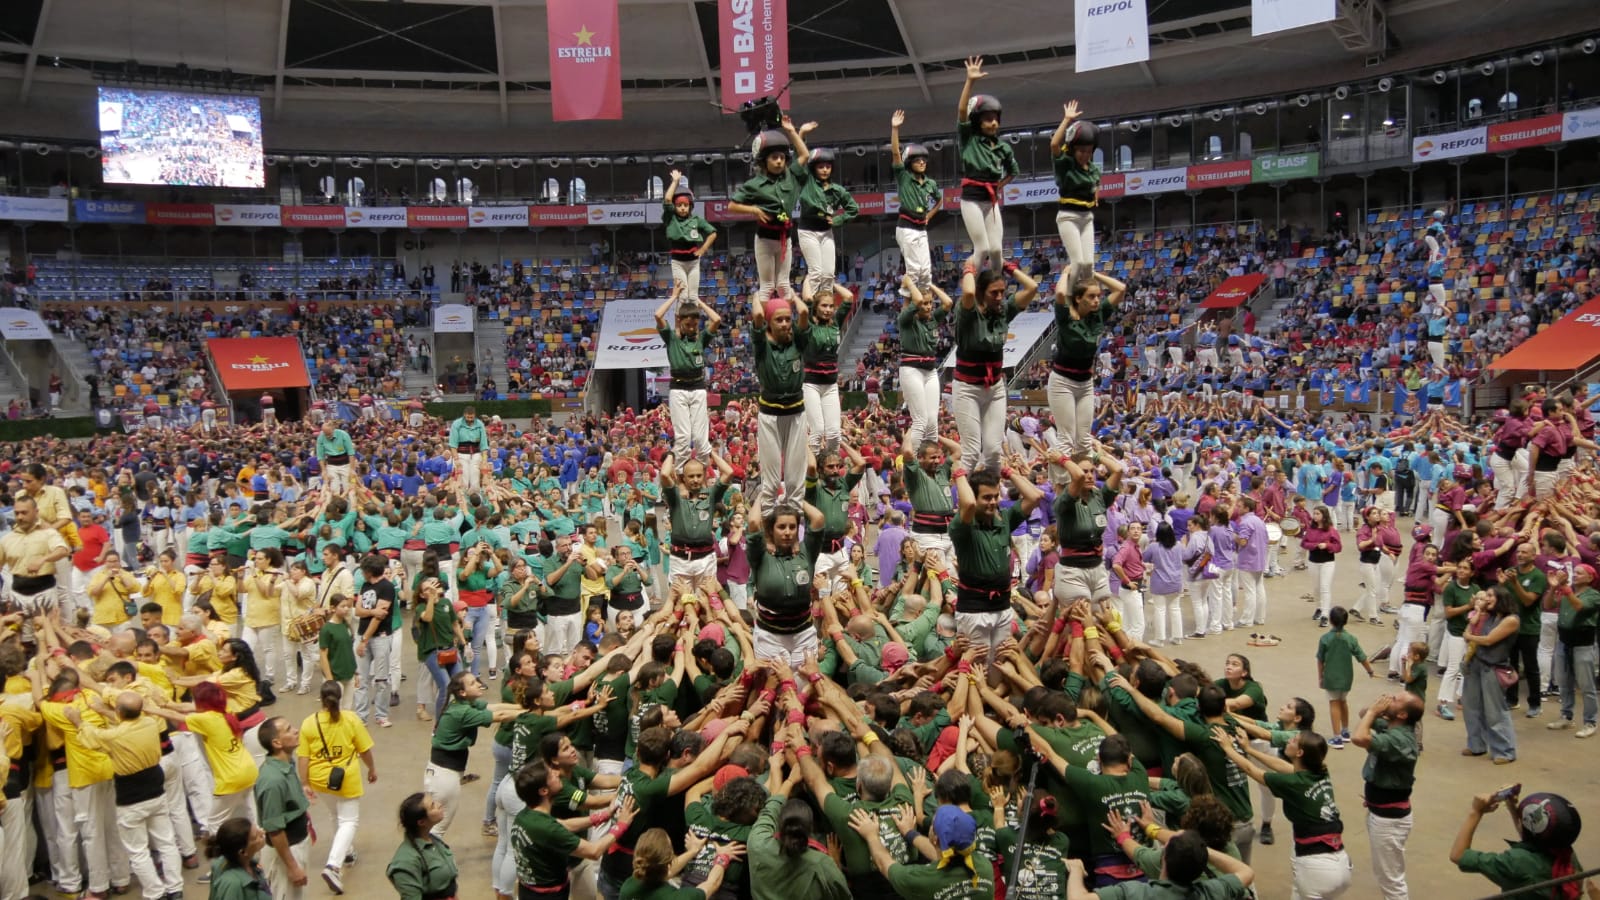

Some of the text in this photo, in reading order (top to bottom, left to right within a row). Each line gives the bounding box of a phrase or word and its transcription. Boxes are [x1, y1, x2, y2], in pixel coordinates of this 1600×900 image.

[1088, 0, 1133, 17] REPSOL
[731, 0, 755, 54] BAS
[558, 46, 612, 58] ESTRELLA
[764, 34, 773, 71] create
[764, 73, 774, 92] We
[1500, 130, 1536, 142] ESTRELLA
[1440, 137, 1485, 151] REPSOL
[1277, 156, 1309, 168] BASF
[1147, 175, 1185, 186] REPSOL
[1197, 172, 1229, 182] ESTRELLA
[1025, 186, 1060, 197] REPSO
[103, 203, 136, 214] BASF
[609, 210, 645, 218] REPSOL
[240, 212, 280, 220] REPSOL
[369, 213, 406, 221] REPSOL
[416, 214, 447, 222] ESTRELLA
[491, 213, 528, 221] REPSOL
